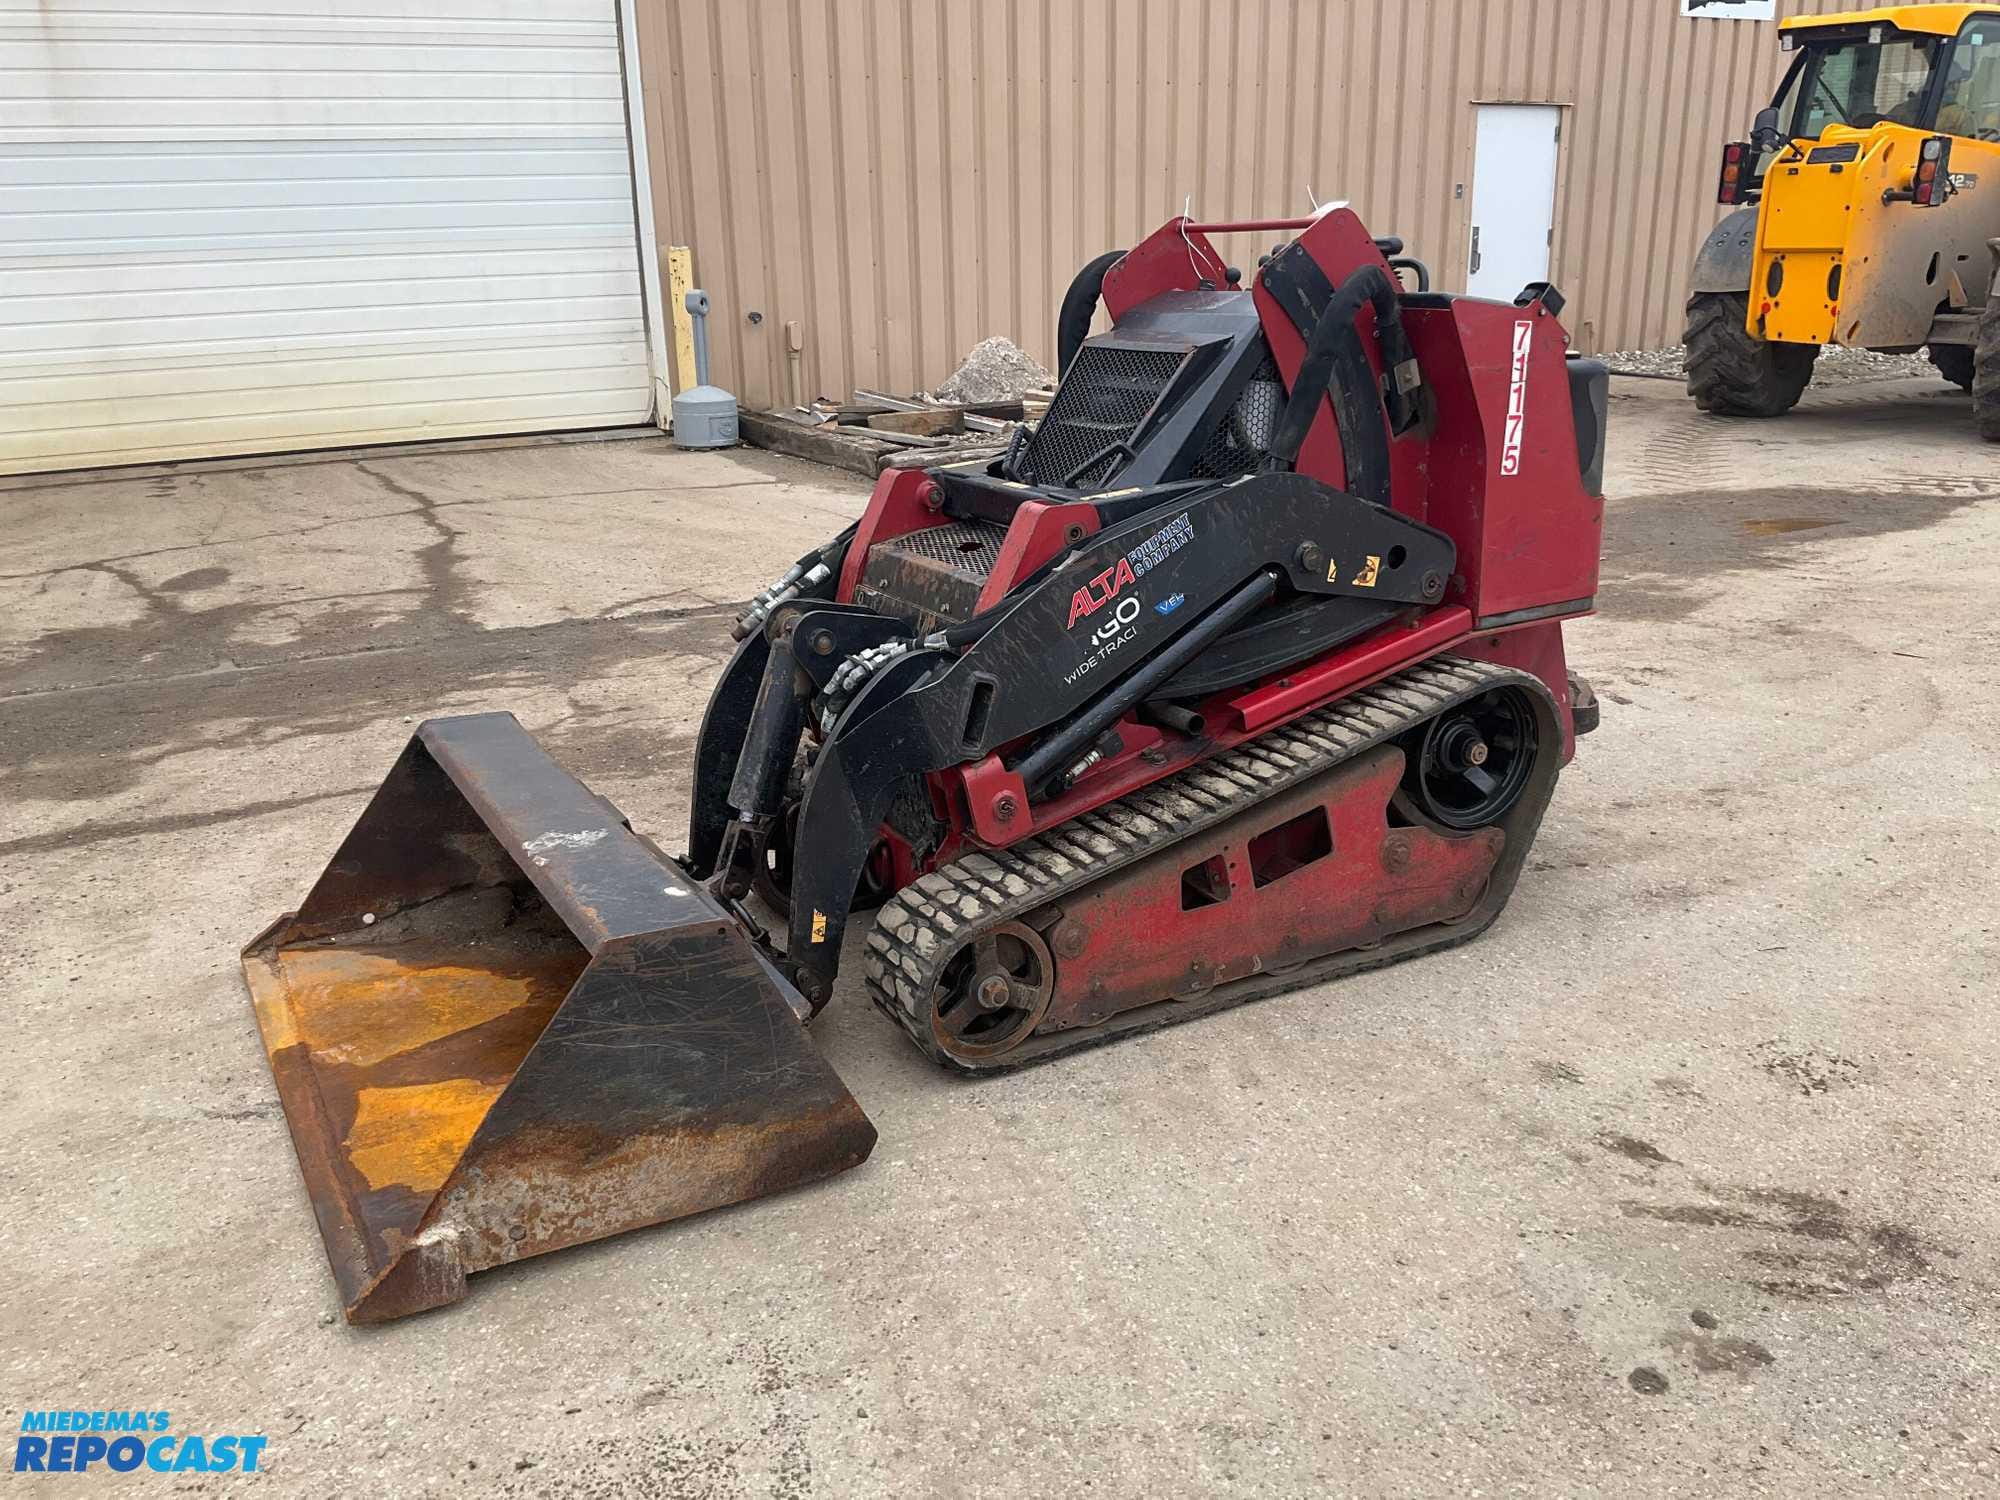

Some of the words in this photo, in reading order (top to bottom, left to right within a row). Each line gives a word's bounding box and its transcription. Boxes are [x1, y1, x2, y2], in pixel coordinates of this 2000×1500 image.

[1502, 322, 1530, 474] 71175
[1133, 524, 1194, 577] COMPANY
[1067, 558, 1136, 630] ALTA
[1064, 656, 1098, 684] WIDE
